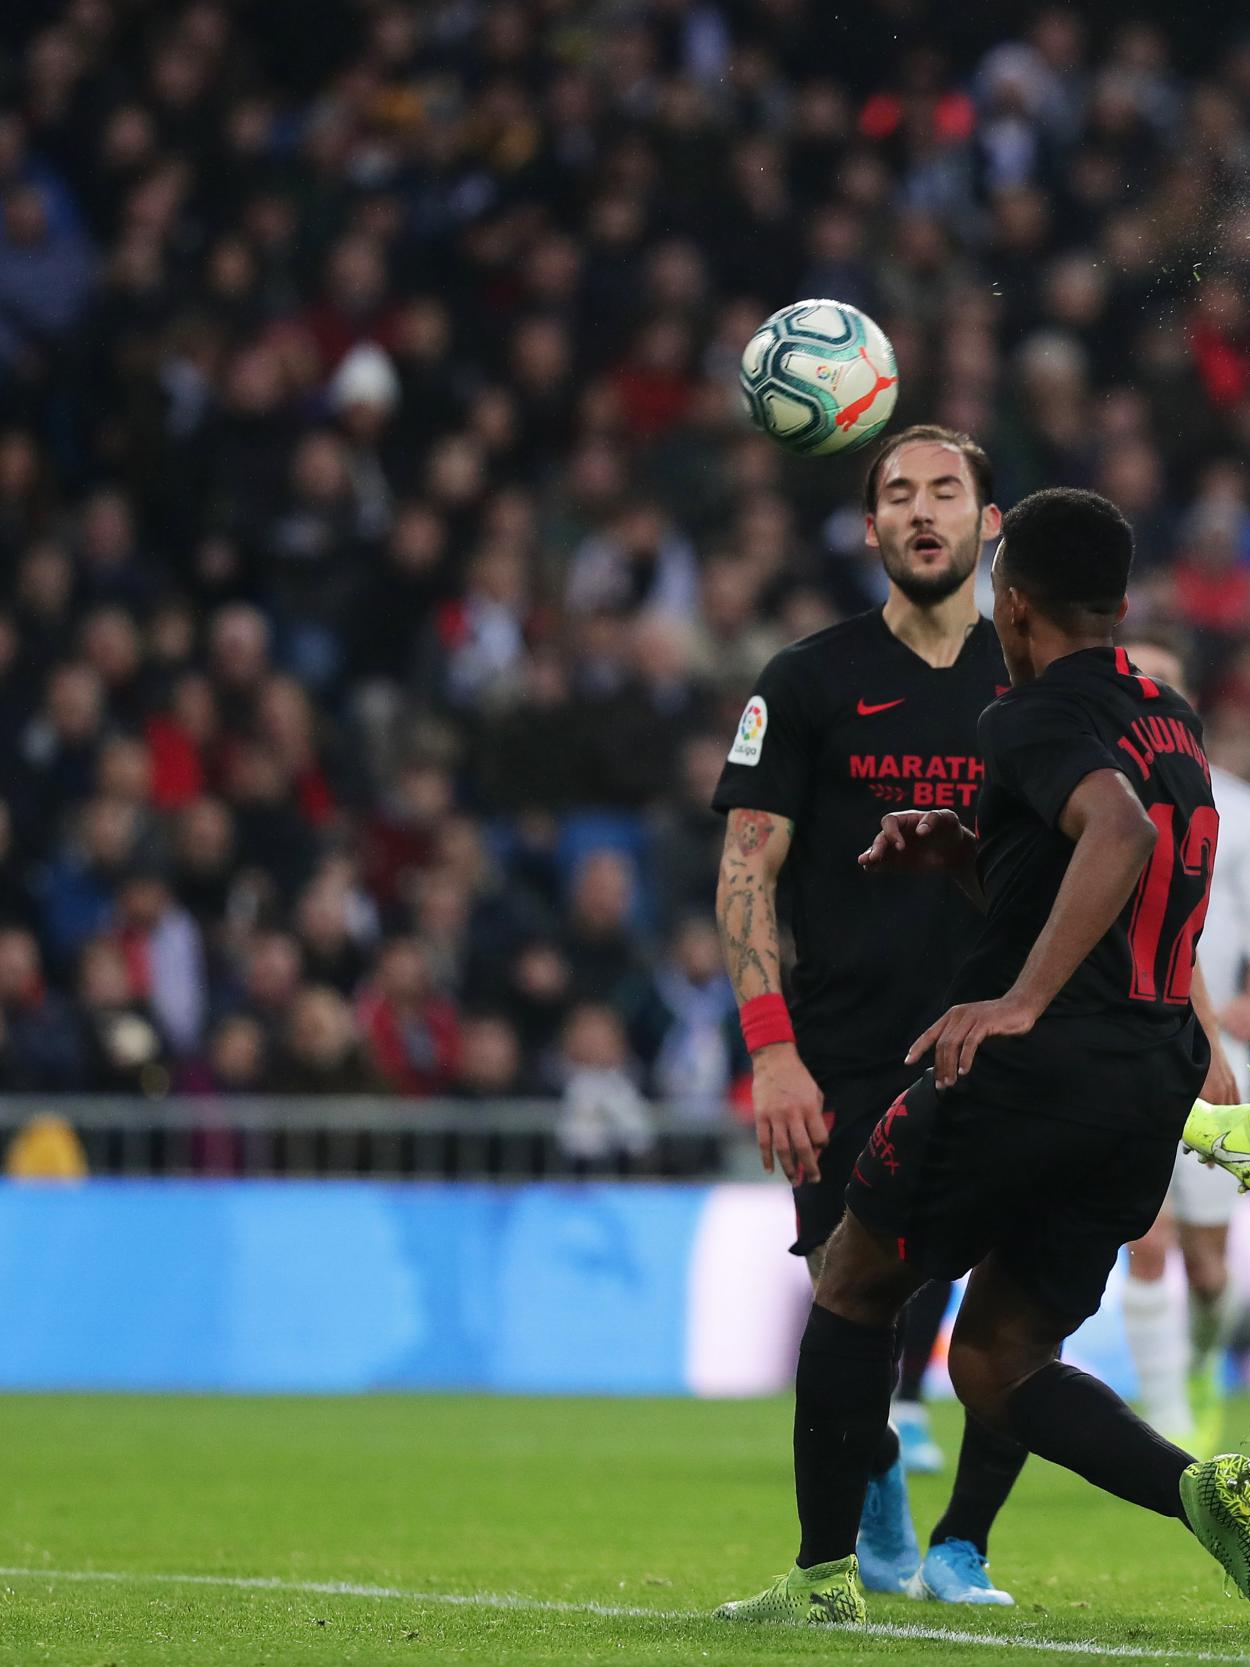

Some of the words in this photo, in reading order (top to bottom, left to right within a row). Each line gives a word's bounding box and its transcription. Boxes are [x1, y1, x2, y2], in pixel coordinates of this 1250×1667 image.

[849, 755, 984, 780] MARATH
[914, 782, 977, 806] BET
[1129, 803, 1219, 1005] 12
